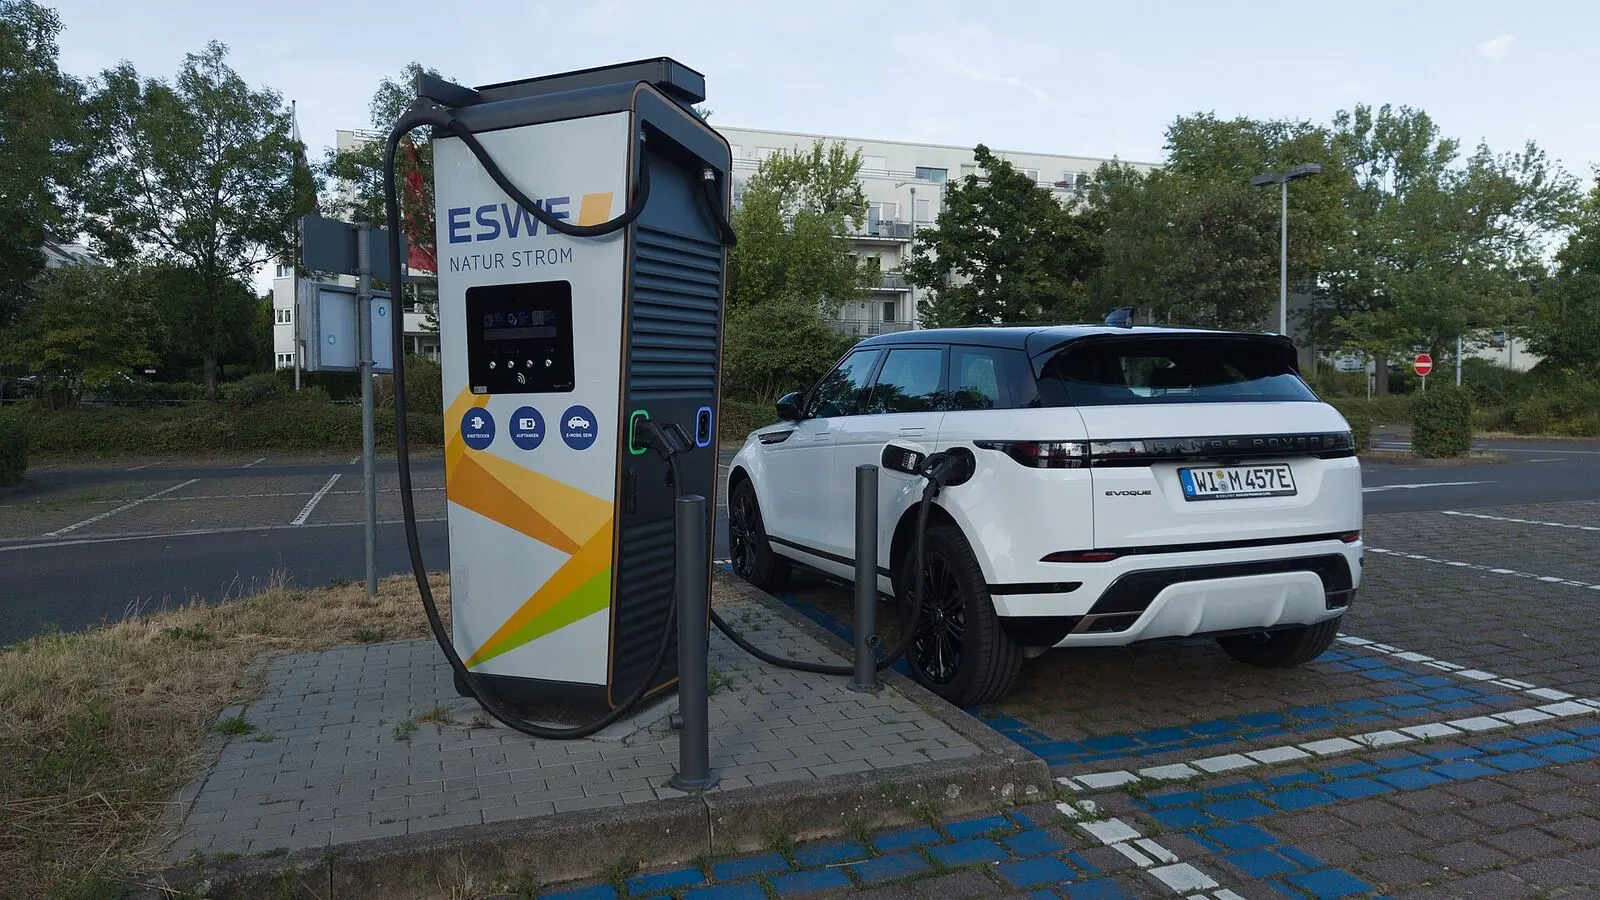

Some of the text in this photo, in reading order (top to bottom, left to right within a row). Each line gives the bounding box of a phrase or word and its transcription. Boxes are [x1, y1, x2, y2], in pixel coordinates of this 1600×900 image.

[448, 196, 570, 244] ESWE
[450, 247, 573, 273] NATUR STROM
[1153, 439, 1241, 452] RANGE
[1194, 471, 1219, 492] WI
